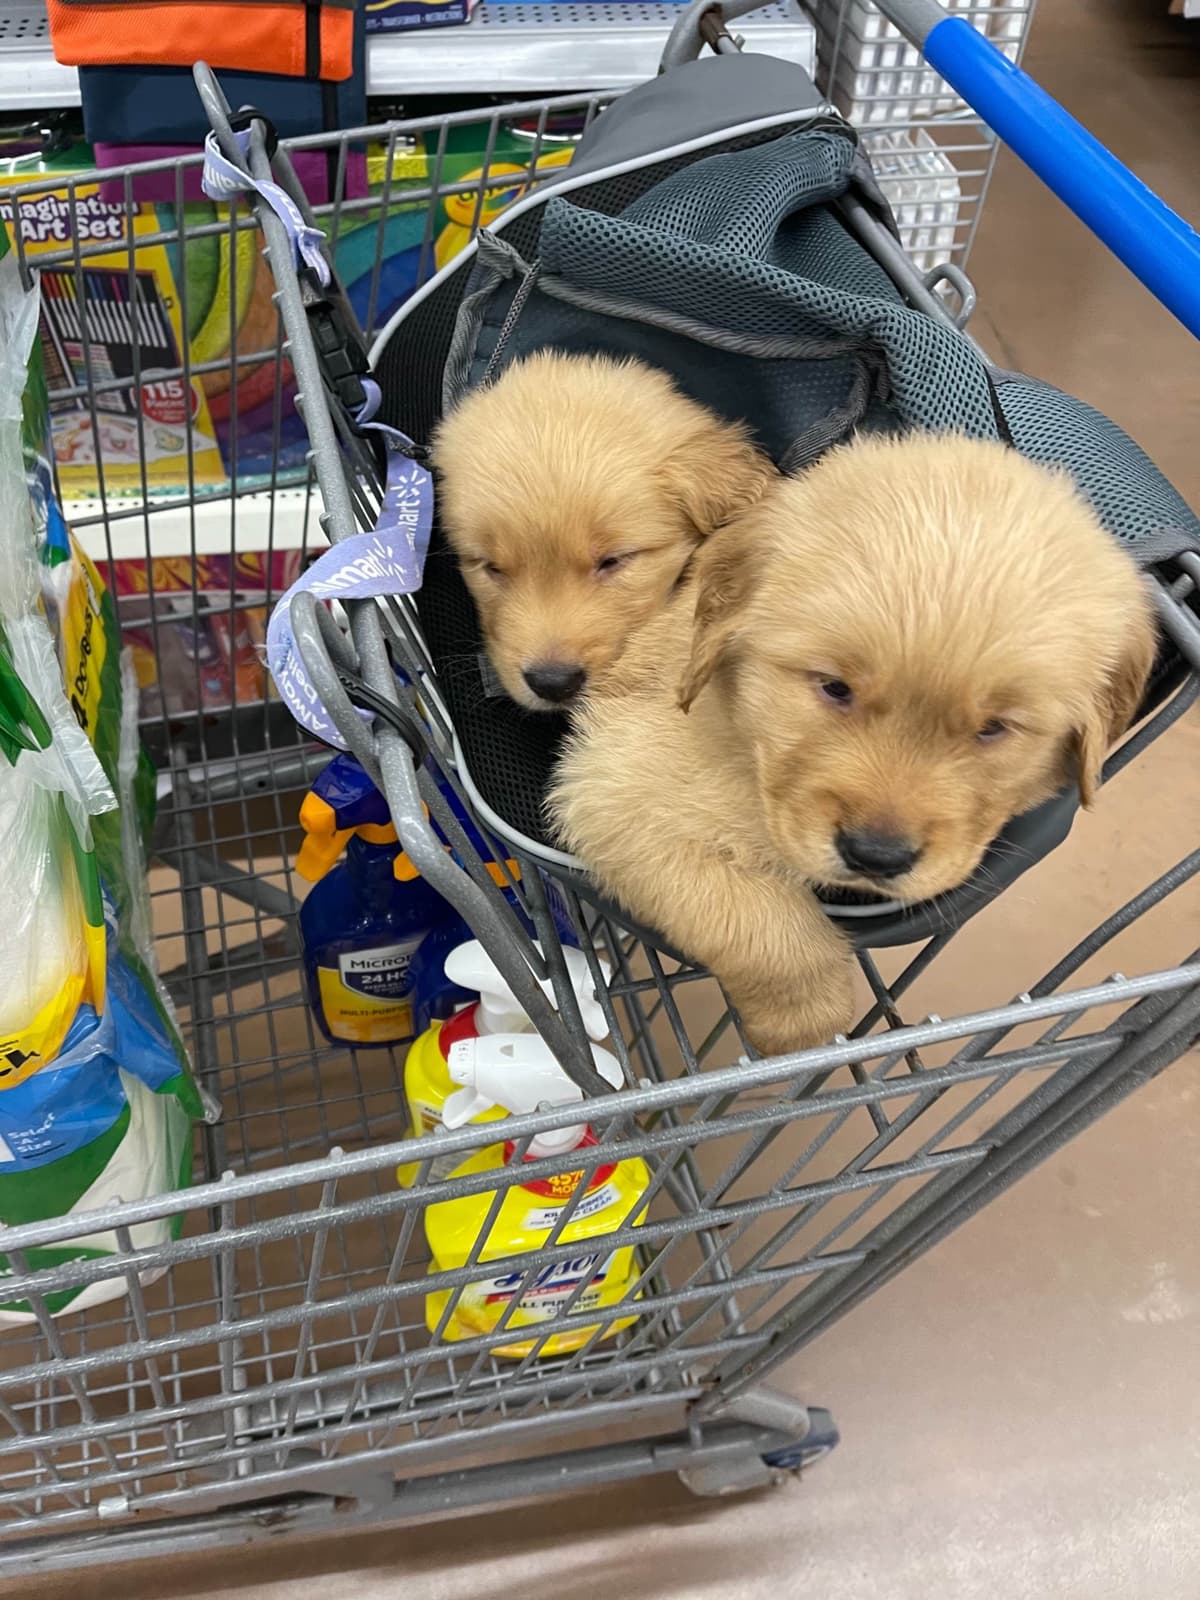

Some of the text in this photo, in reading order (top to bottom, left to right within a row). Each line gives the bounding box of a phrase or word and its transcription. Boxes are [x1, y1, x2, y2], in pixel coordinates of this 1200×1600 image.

[21, 216, 121, 239] Art Set
[143, 380, 183, 398] 115
[361, 975, 383, 984] 24
[17, 1140, 52, 1152] Size
